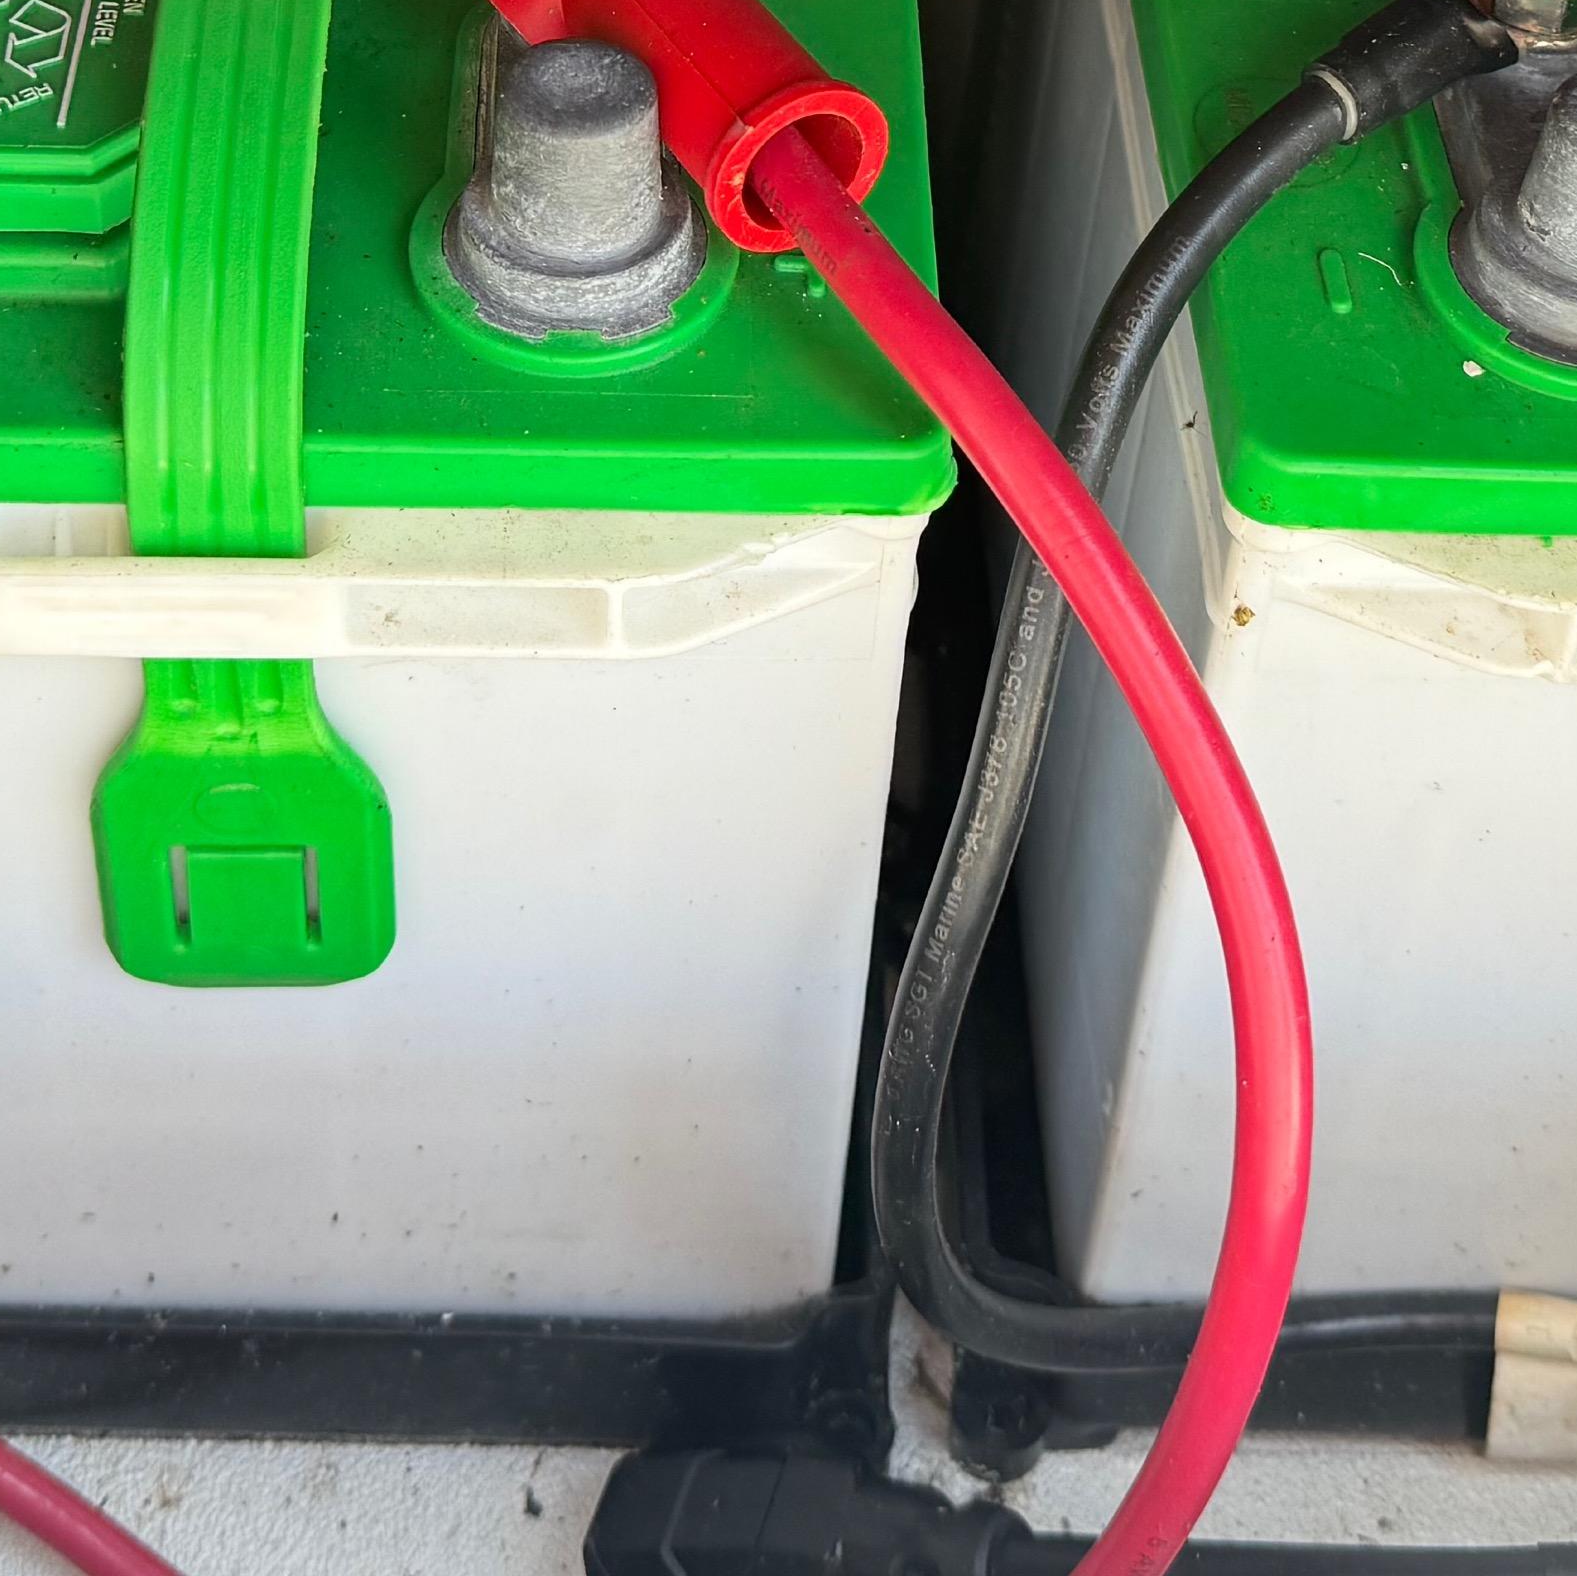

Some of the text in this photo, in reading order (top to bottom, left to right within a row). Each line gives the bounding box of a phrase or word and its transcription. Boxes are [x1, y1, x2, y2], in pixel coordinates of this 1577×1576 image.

[89, 2, 118, 46] LEVEL
[1076, 364, 1120, 431] Volts
[1110, 235, 1193, 356] Maximum
[926, 869, 965, 965] Marine
[1019, 587, 1044, 641] and
